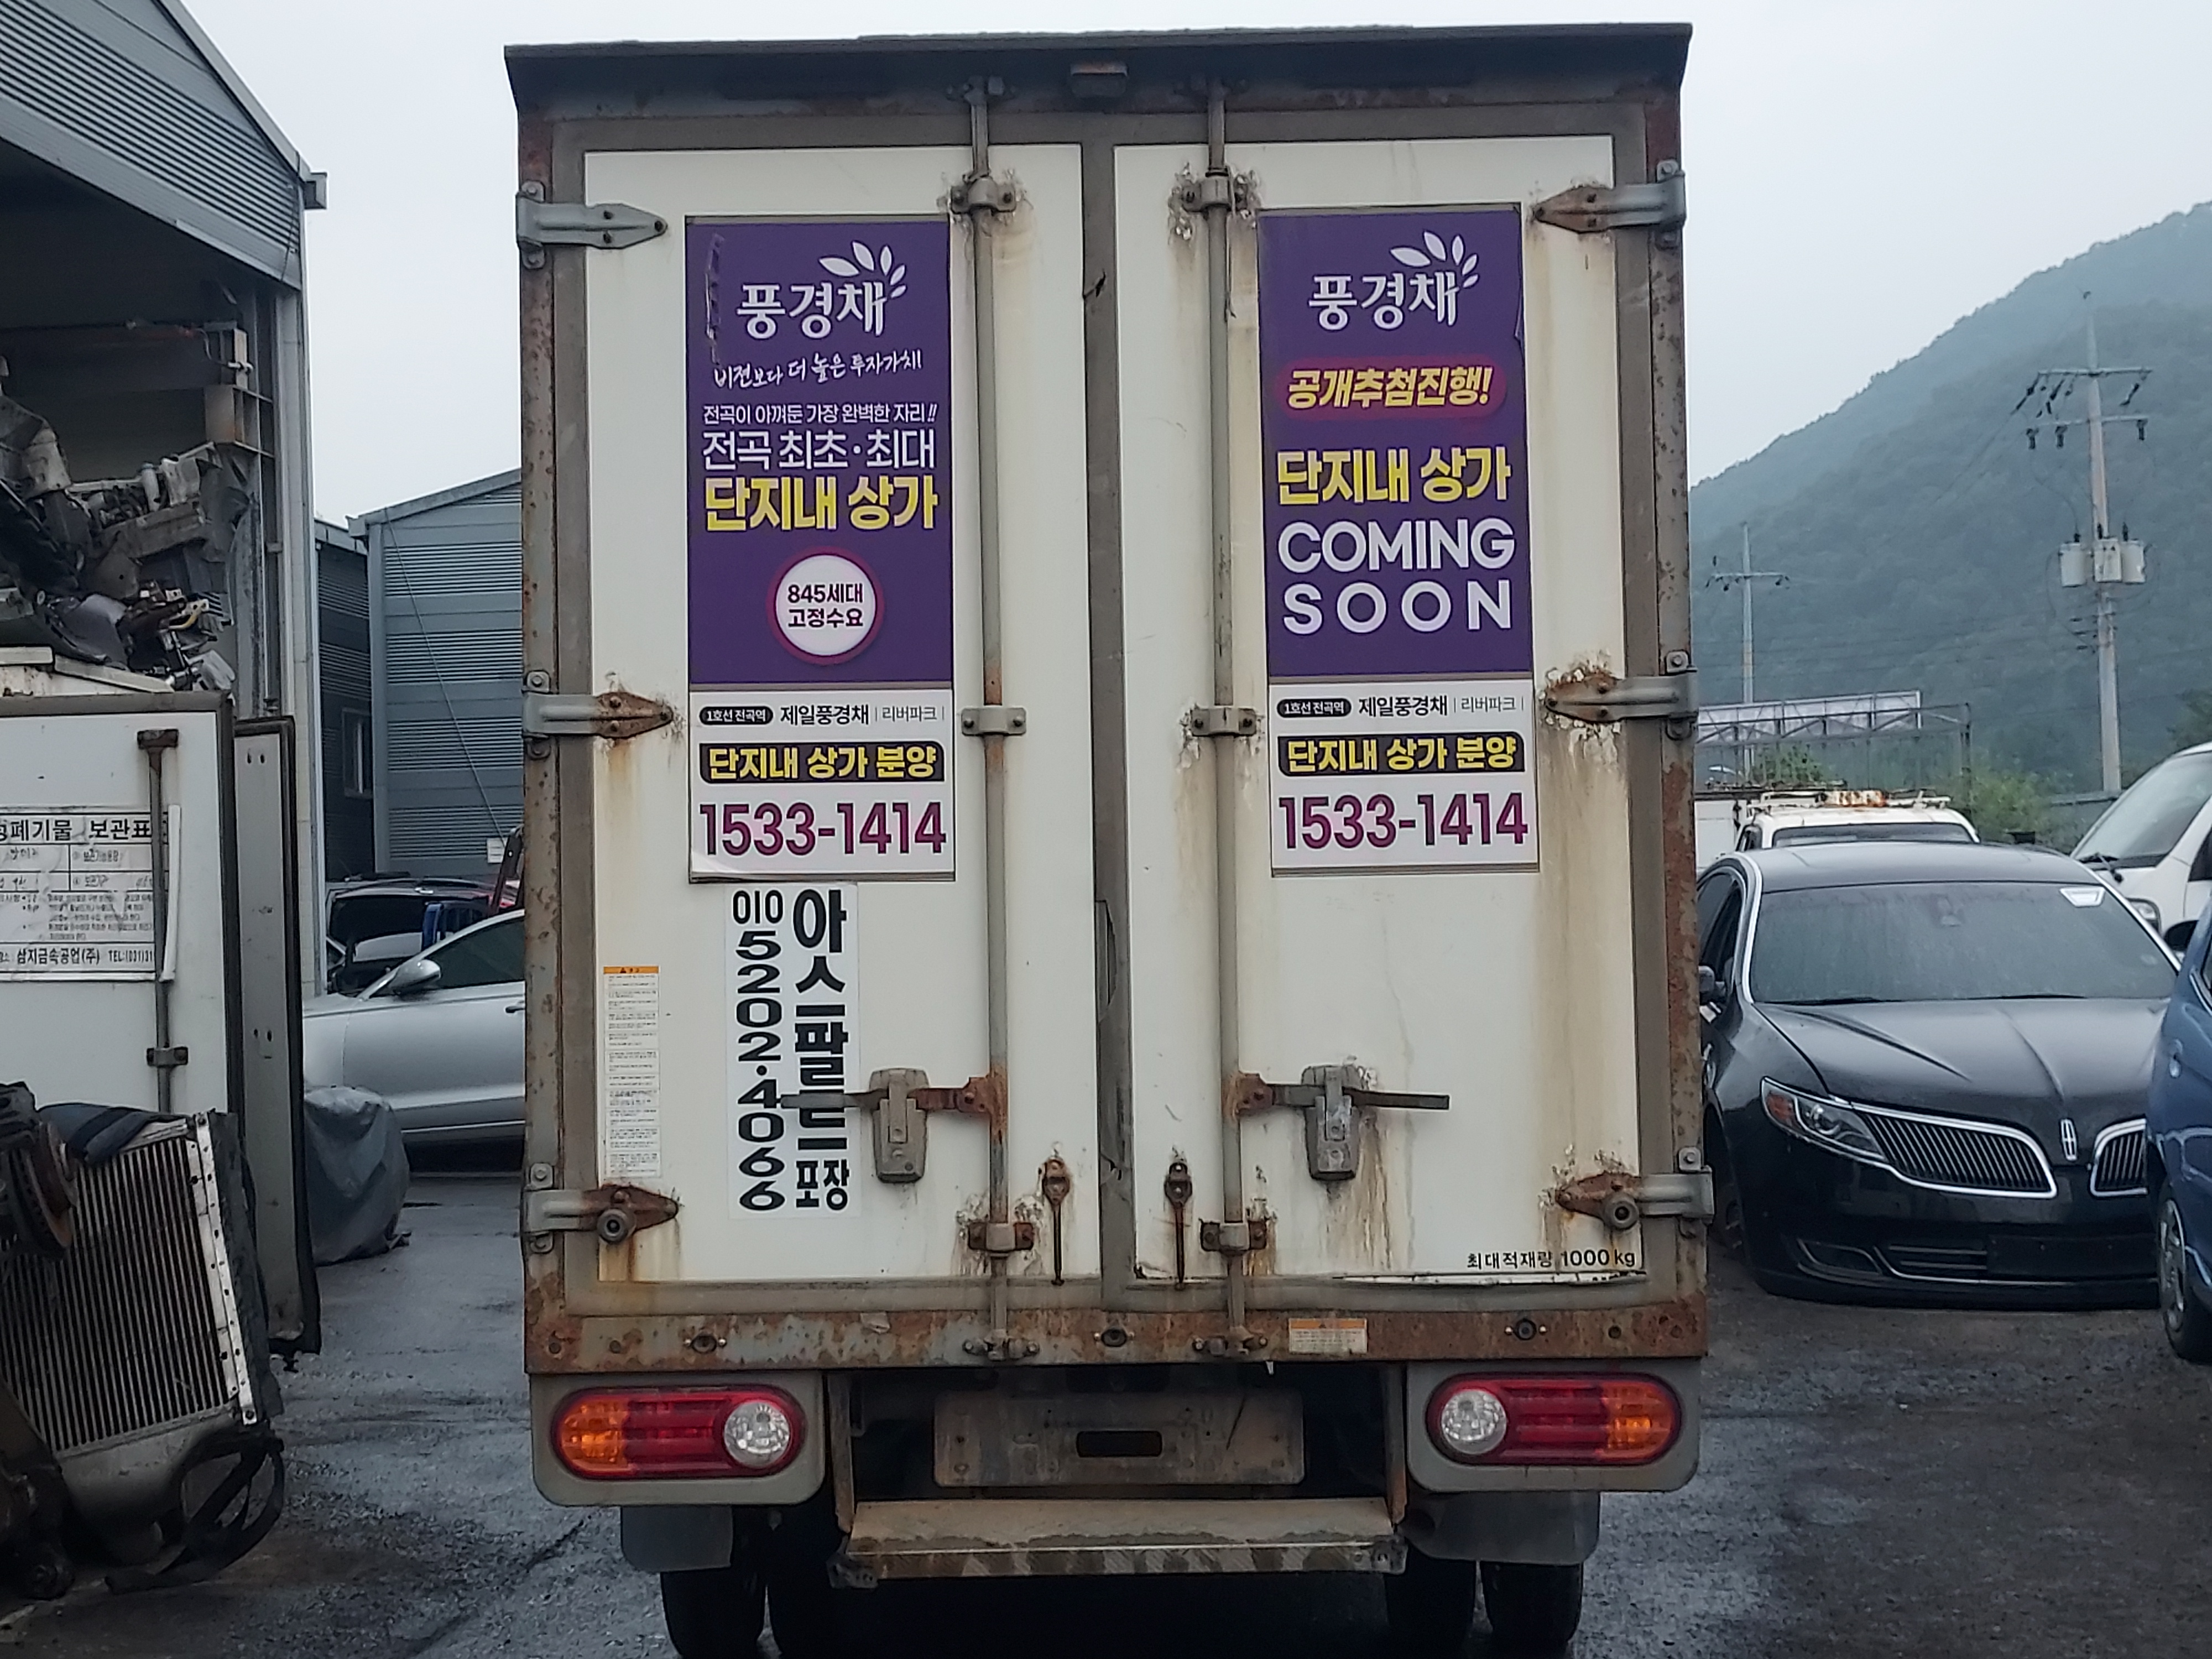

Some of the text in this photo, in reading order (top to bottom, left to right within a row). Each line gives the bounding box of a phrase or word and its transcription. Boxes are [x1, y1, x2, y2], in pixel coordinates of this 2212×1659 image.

[737, 281, 888, 340] 풍경채
[1308, 271, 1460, 331] 풍경채
[788, 357, 806, 381] 더
[811, 352, 846, 383] 높은
[1288, 366, 1493, 409] 공개추첨진행!
[703, 404, 750, 425] 전곡이
[755, 404, 803, 425] 아껴둔
[806, 404, 838, 424] 가장
[842, 403, 890, 424] 완벽한
[703, 431, 771, 471] 전곡
[1277, 446, 1511, 505] 단지내 상가
[705, 475, 938, 531] 단지내 상가
[1278, 518, 1515, 573] COMING
[787, 583, 863, 604] 845세대
[1283, 578, 1512, 635] SOON
[788, 608, 864, 628] 고정수요
[780, 705, 869, 726] 제일풍경채
[882, 706, 938, 722] 리버파크
[1284, 702, 1312, 715] 1호선
[1358, 695, 1447, 717] 제일풍경채
[1460, 697, 1516, 713] 리버파크
[709, 746, 936, 780] 단지내 상가 분양
[1287, 735, 1516, 773] 단지내 상가 분양
[88, 818, 152, 839] 보관표
[699, 802, 947, 856] 1533-1414
[1279, 792, 1528, 849] 1533-1414
[795, 1159, 850, 1211] 포장
[1467, 1249, 1636, 1270] 최대적재량 1000 kg
